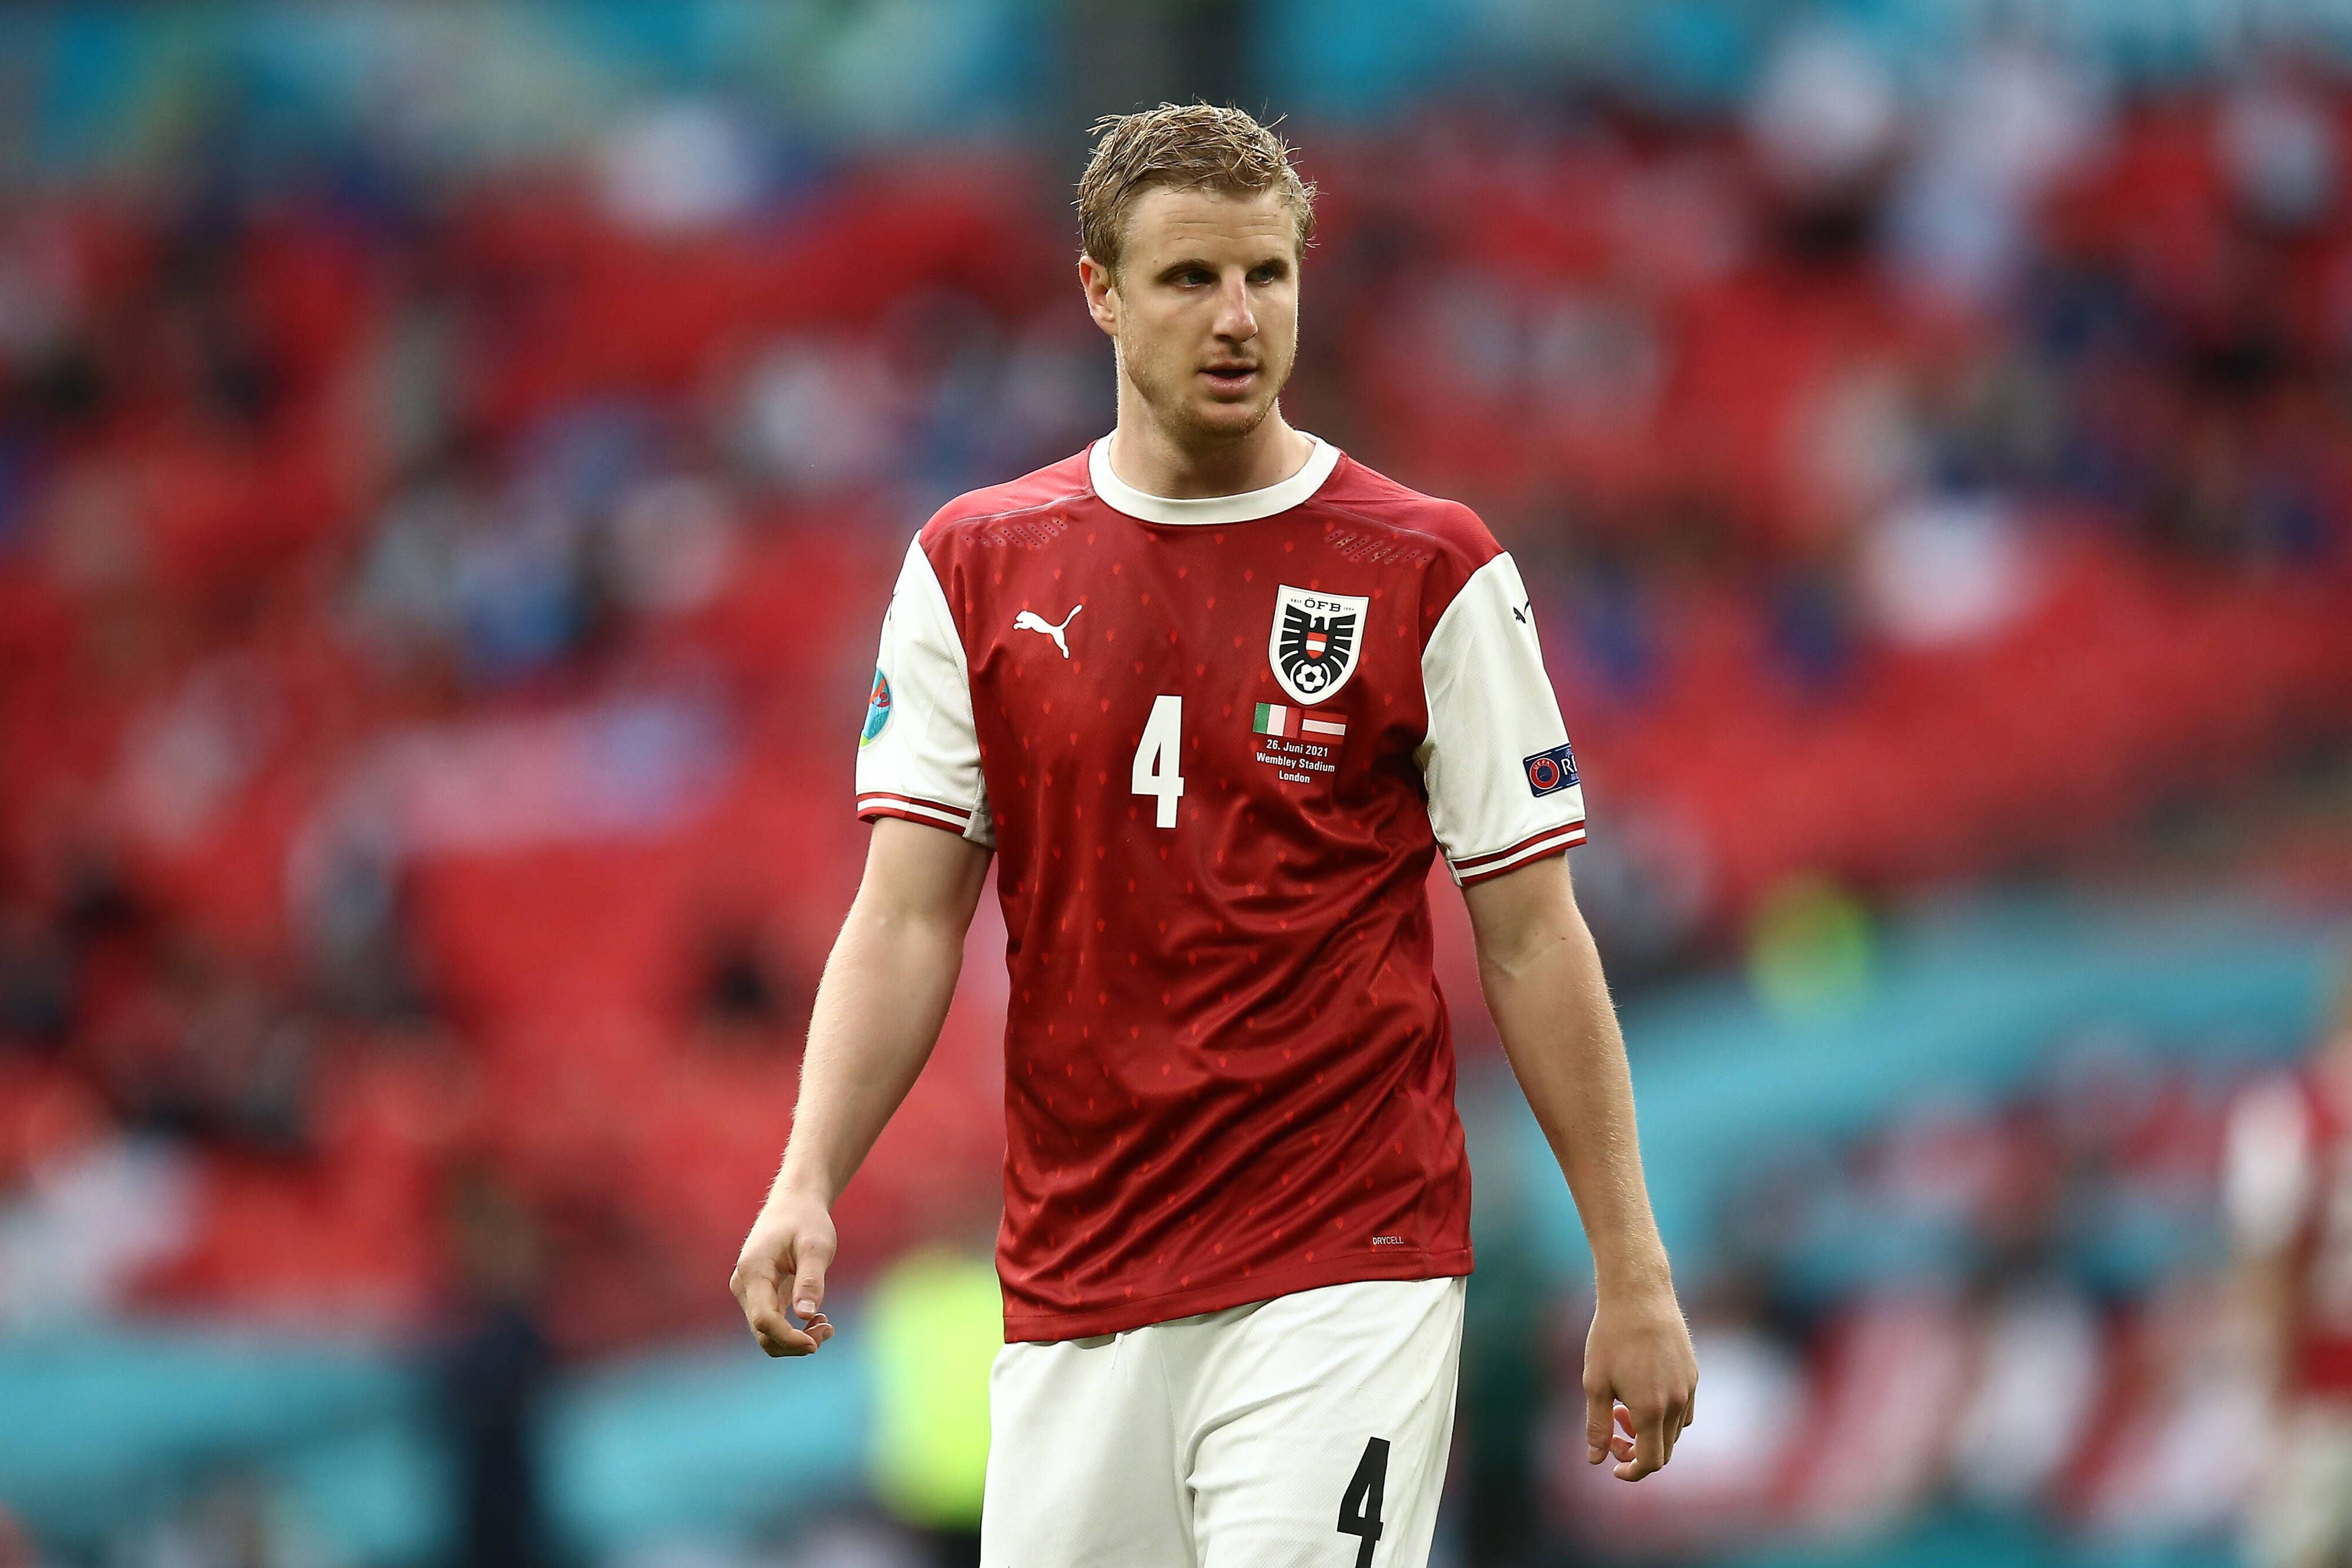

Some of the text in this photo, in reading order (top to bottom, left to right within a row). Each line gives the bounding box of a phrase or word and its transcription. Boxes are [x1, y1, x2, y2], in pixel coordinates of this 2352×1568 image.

[1304, 597, 1341, 612] ÖFB
[1266, 739, 1328, 757] 26. Juni 2021
[1131, 695, 1185, 828] 4
[1256, 752, 1335, 772] Wembley Stadium
[1533, 760, 1551, 770] UEFA
[1279, 770, 1311, 784] London
[1372, 1236, 1404, 1245] DRYCELL
[1337, 1436, 1391, 1568] 4
